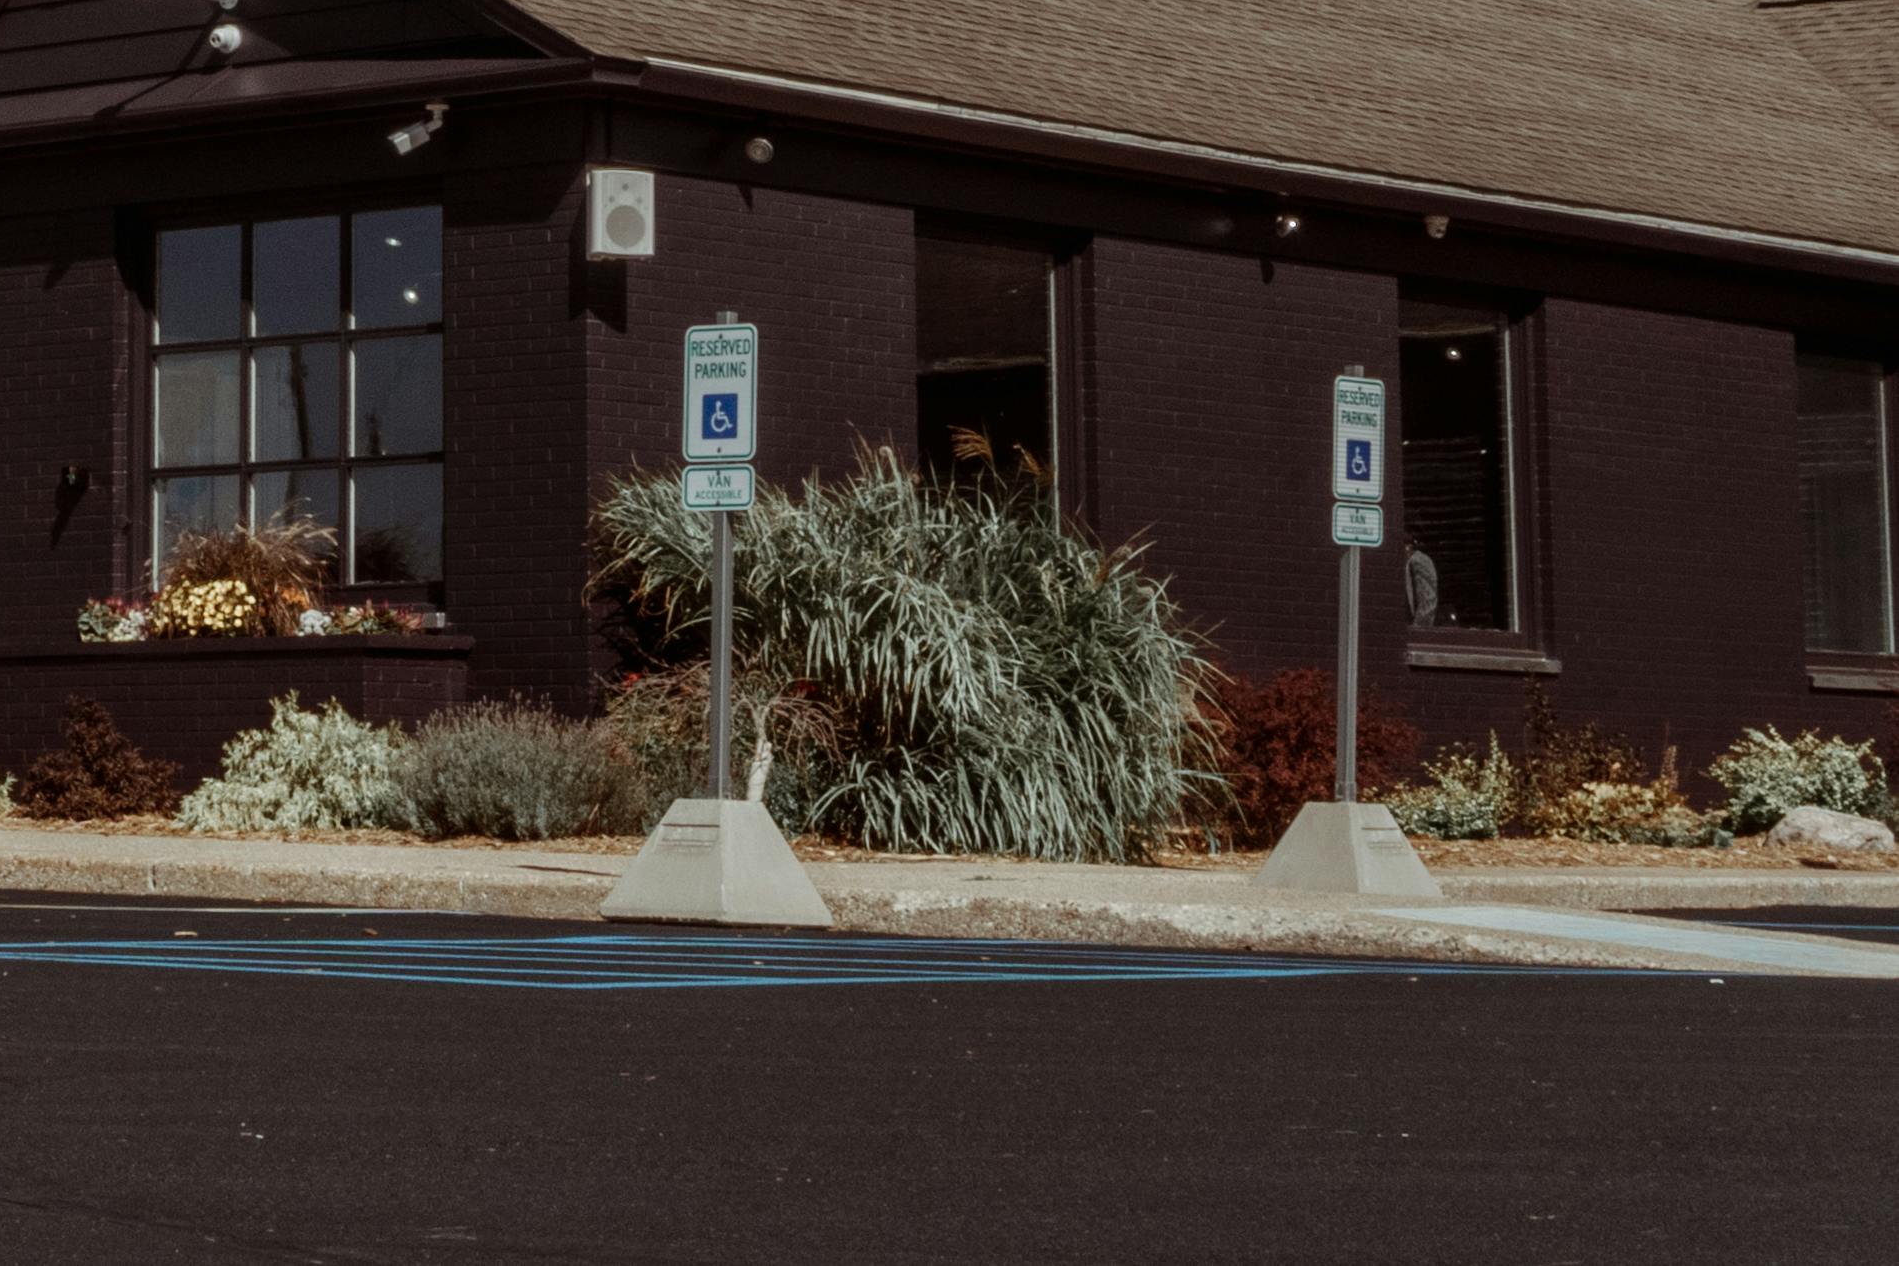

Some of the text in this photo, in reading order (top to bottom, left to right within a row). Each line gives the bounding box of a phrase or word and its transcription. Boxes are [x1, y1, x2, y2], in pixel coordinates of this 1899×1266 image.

[691, 339, 751, 357] RESERVED
[695, 361, 747, 379] PARKING
[1337, 390, 1381, 407] RESERVED
[1342, 410, 1377, 427] PARKING
[707, 475, 732, 487] VAN
[694, 490, 742, 500] ACCESSIBLE
[1349, 514, 1366, 525] VAN
